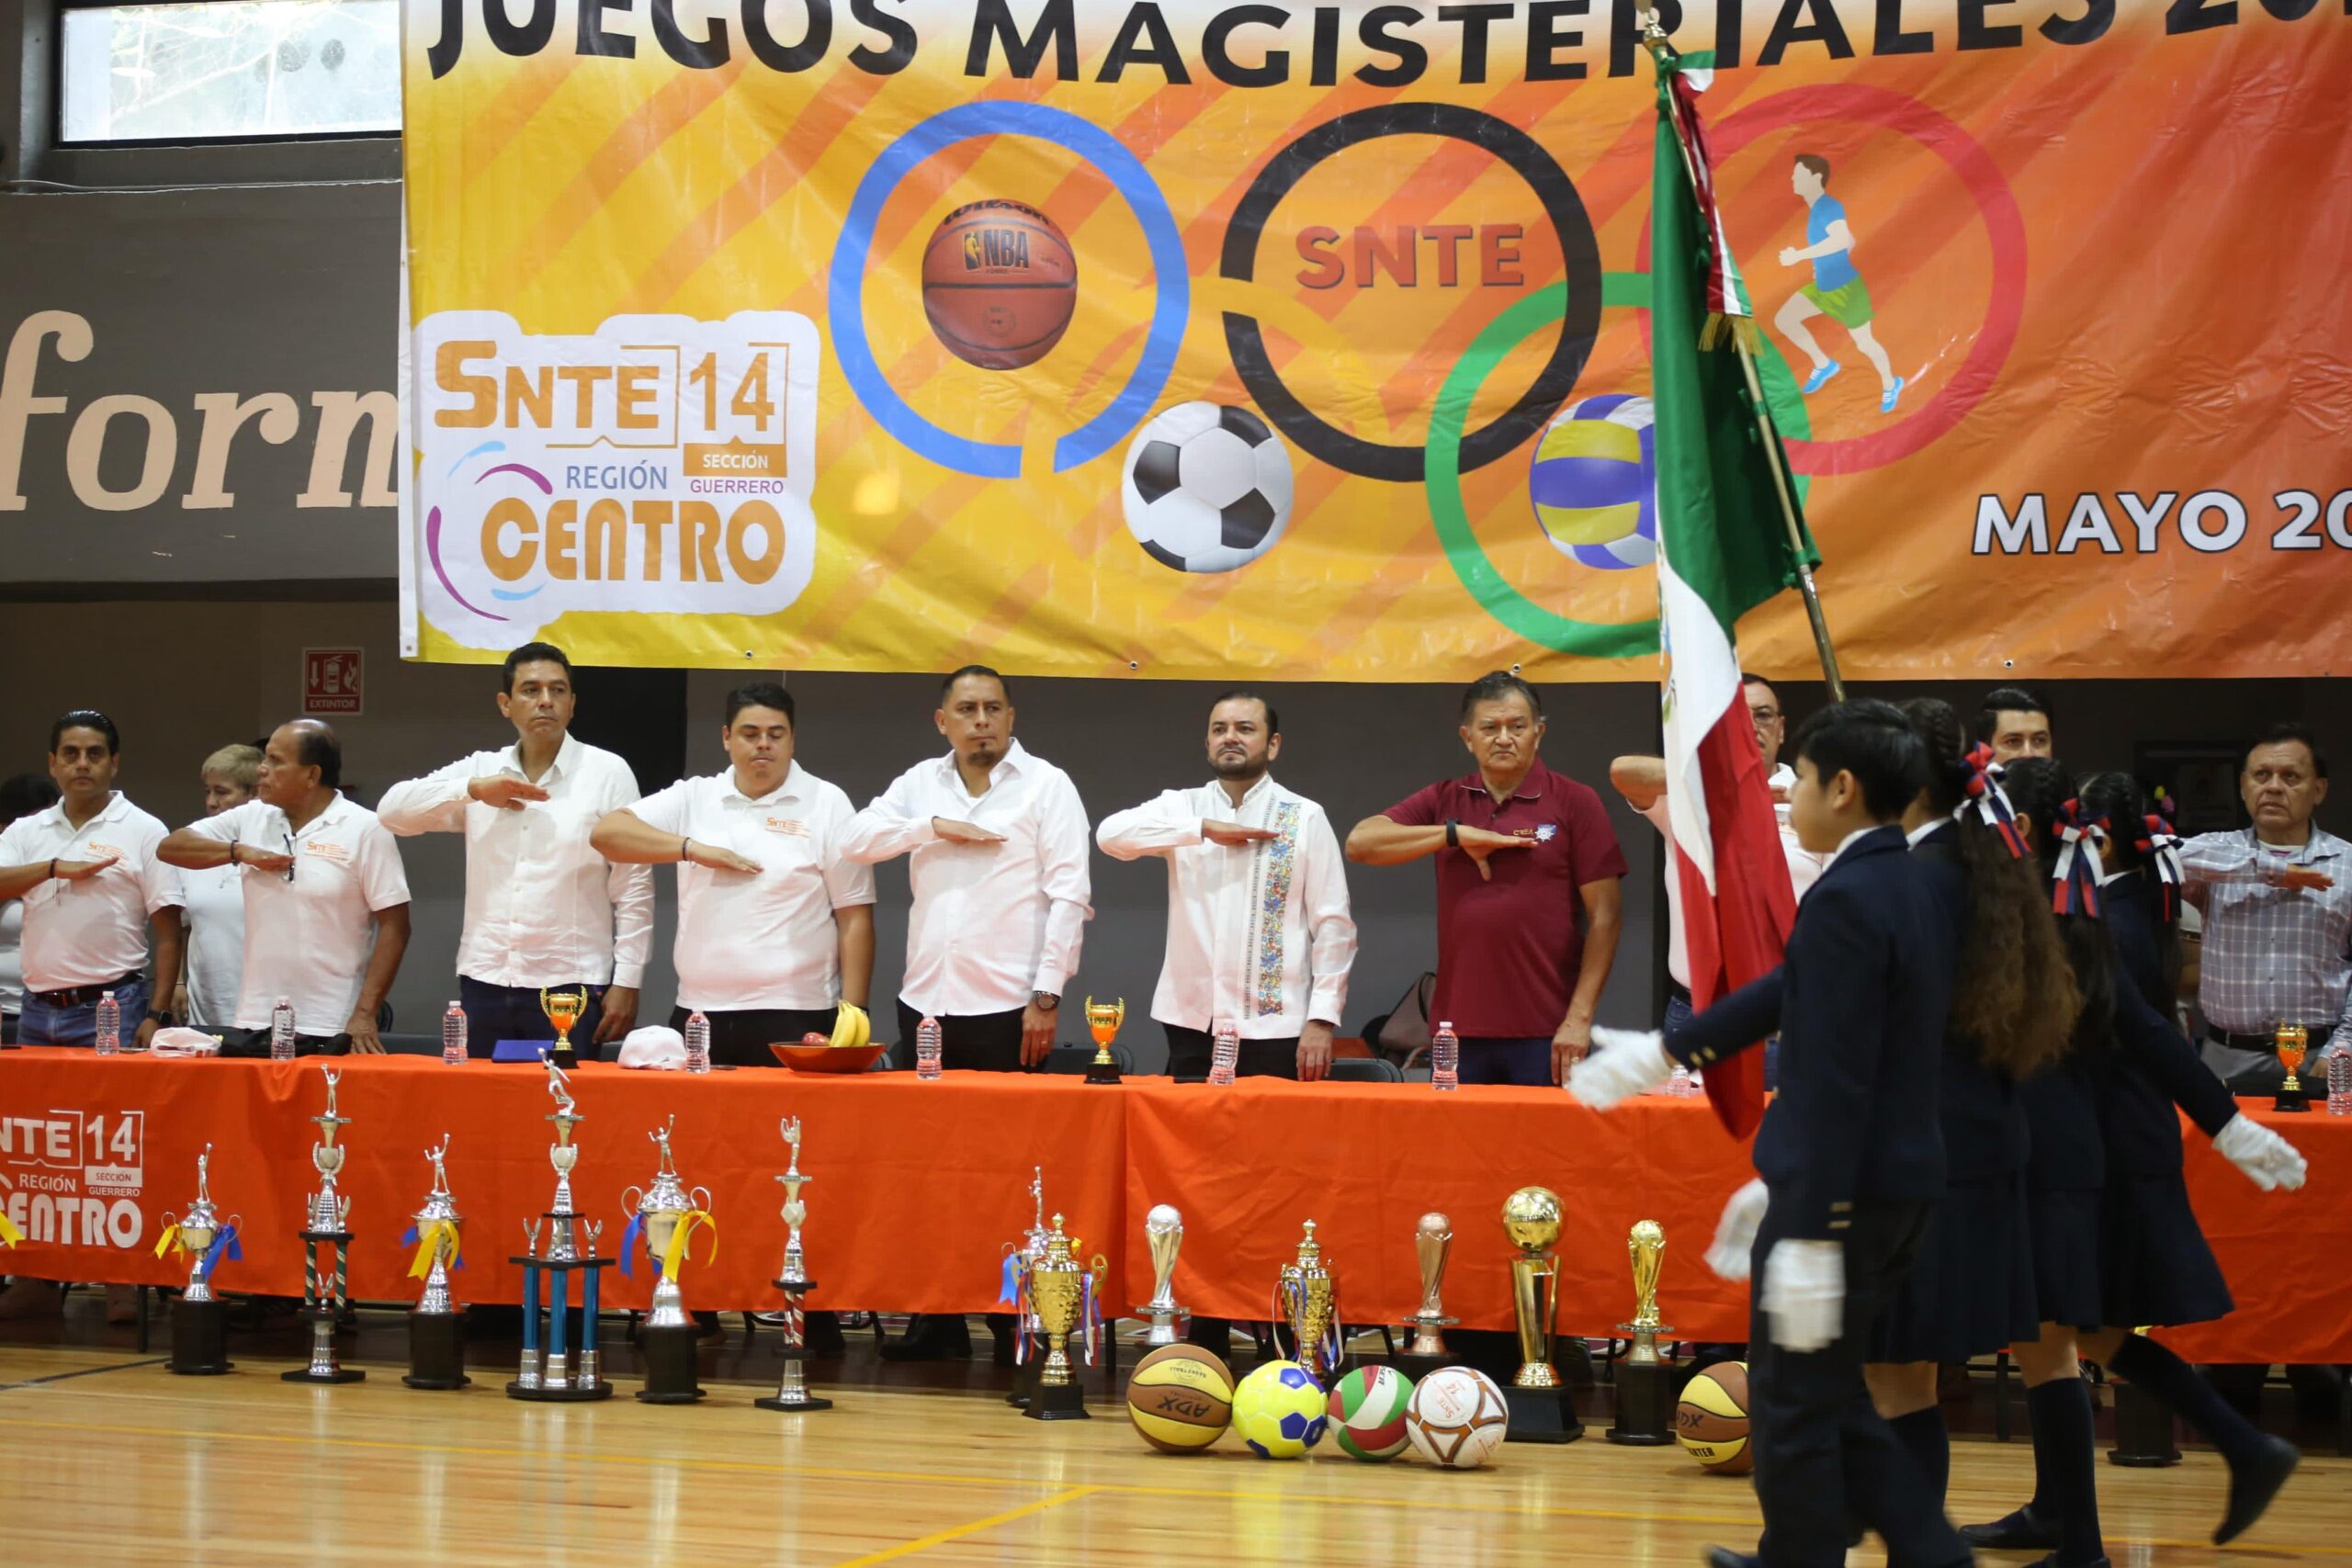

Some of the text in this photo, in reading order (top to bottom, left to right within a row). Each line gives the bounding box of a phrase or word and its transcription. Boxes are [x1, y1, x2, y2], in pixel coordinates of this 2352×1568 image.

[427, 0, 919, 80] JUEGOS
[963, 0, 2117, 87] MAGISTERIALES
[984, 230, 1029, 268] NBA
[1295, 223, 1524, 289] SNTE
[434, 340, 775, 432] SNTE 14
[566, 460, 668, 491] REGIÓN
[703, 450, 768, 469] SECCIÓN
[690, 479, 784, 494] GUERRERO
[1972, 490, 2249, 555] MAYO
[481, 497, 786, 585] CENTRO
[310, 699, 356, 709] EXTINTOR
[86, 1114, 136, 1162] 14
[19, 1173, 76, 1192] REGIÓN
[89, 1187, 140, 1197] GUERRERO
[96, 1171, 131, 1182] SECCIÓN
[0, 1192, 142, 1248] ENTRO
[1157, 1396, 1211, 1417] ADX
